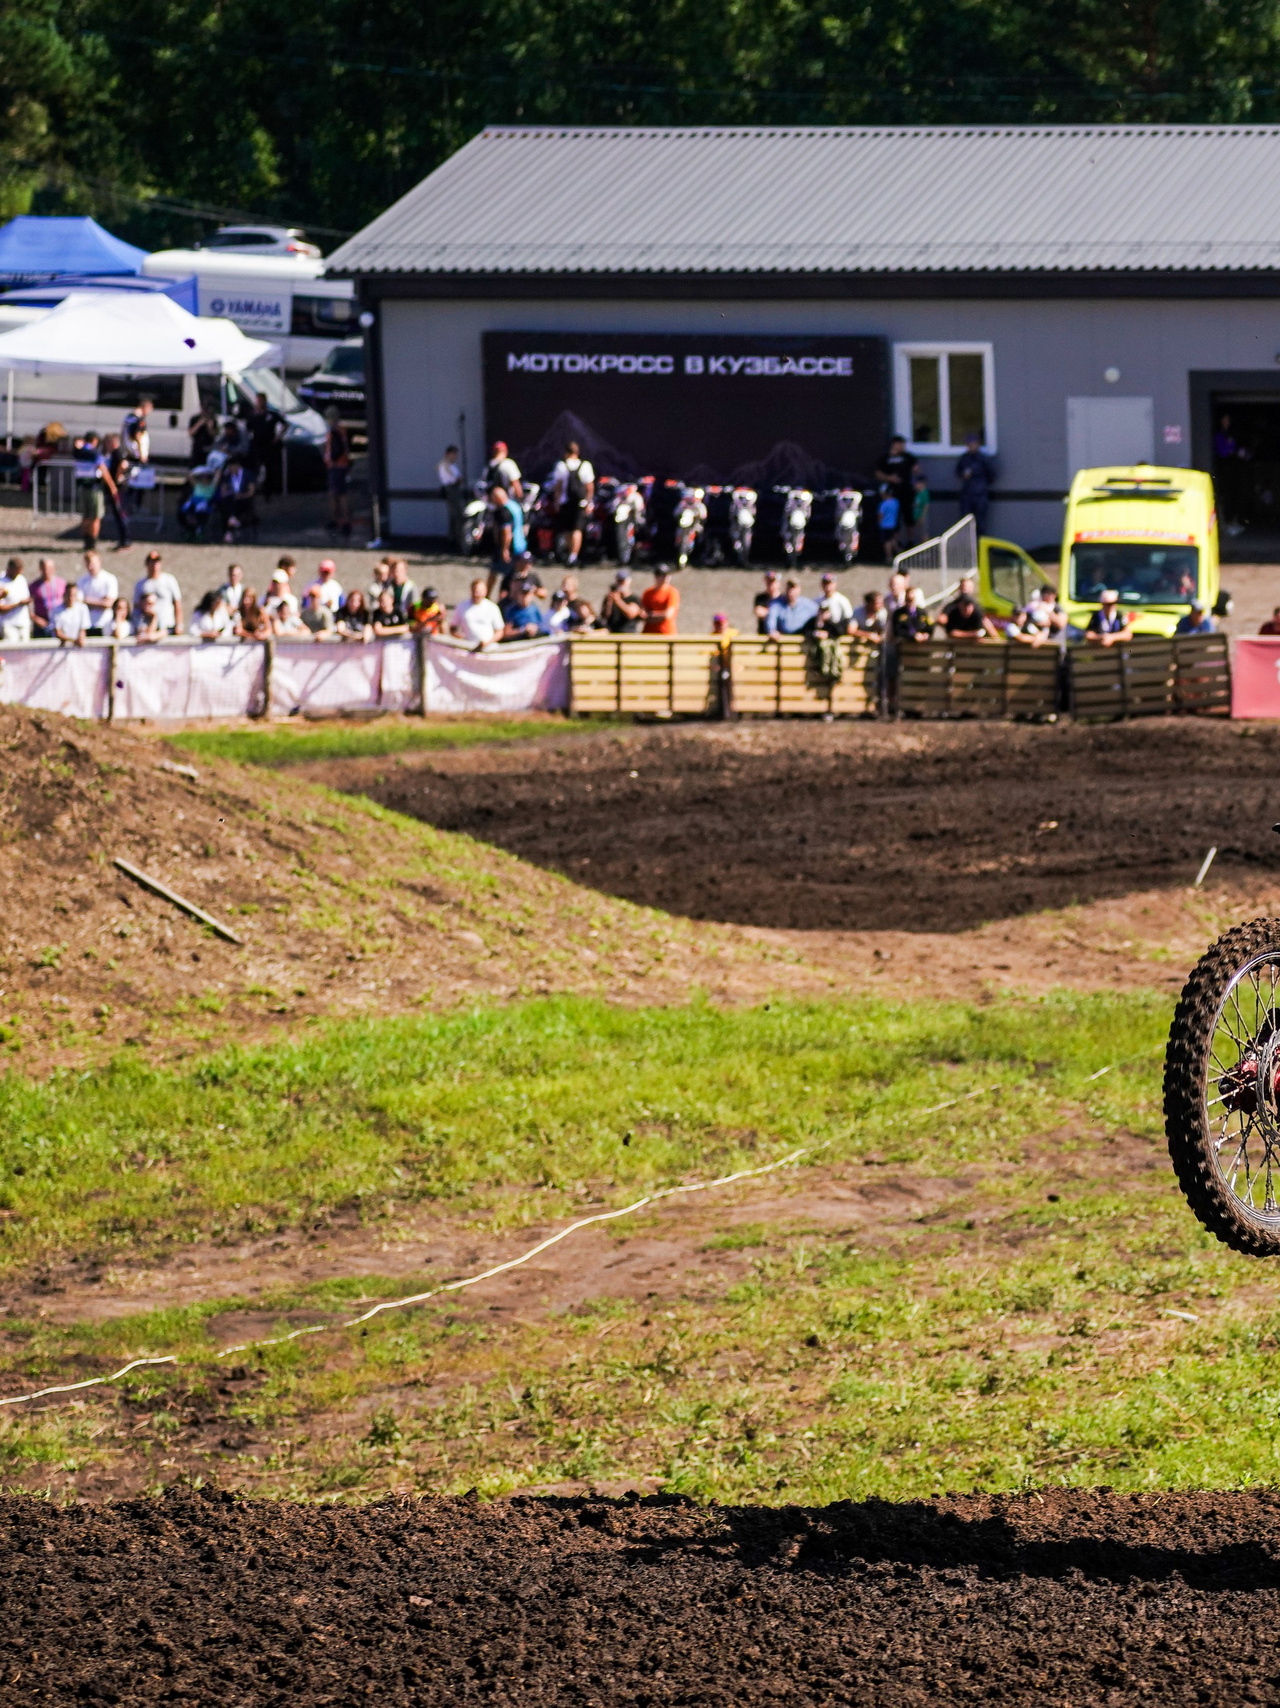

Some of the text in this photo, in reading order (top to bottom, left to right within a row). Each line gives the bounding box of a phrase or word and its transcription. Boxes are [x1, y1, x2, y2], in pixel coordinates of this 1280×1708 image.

[508, 353, 853, 376] МОТОКРОСС В КУЗБАССЕ
